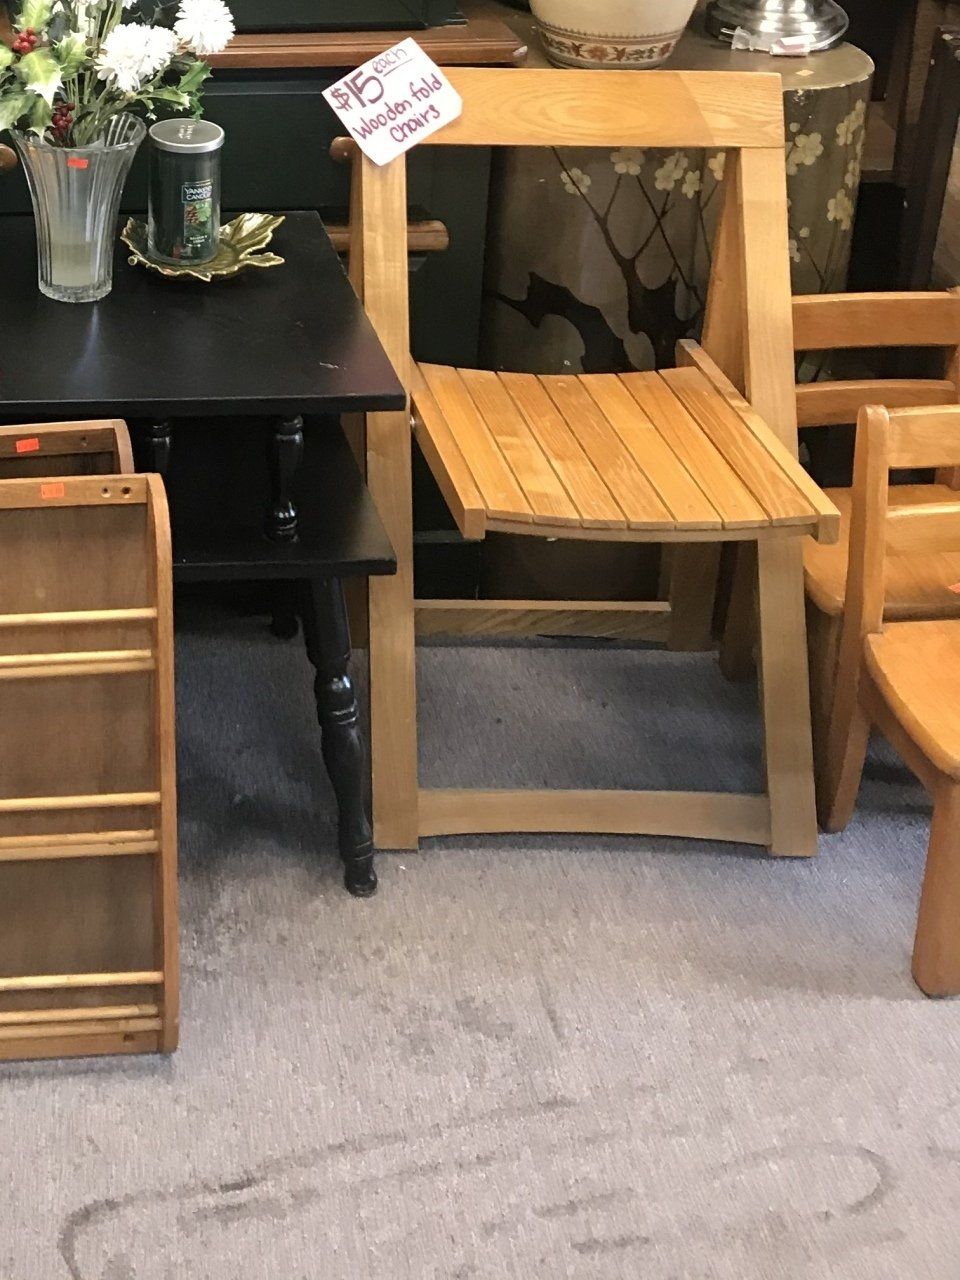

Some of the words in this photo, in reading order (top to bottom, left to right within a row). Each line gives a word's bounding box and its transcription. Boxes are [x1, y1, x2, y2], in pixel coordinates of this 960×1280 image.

[330, 70, 385, 112] $15
[372, 47, 408, 74] each
[409, 73, 443, 102] fold
